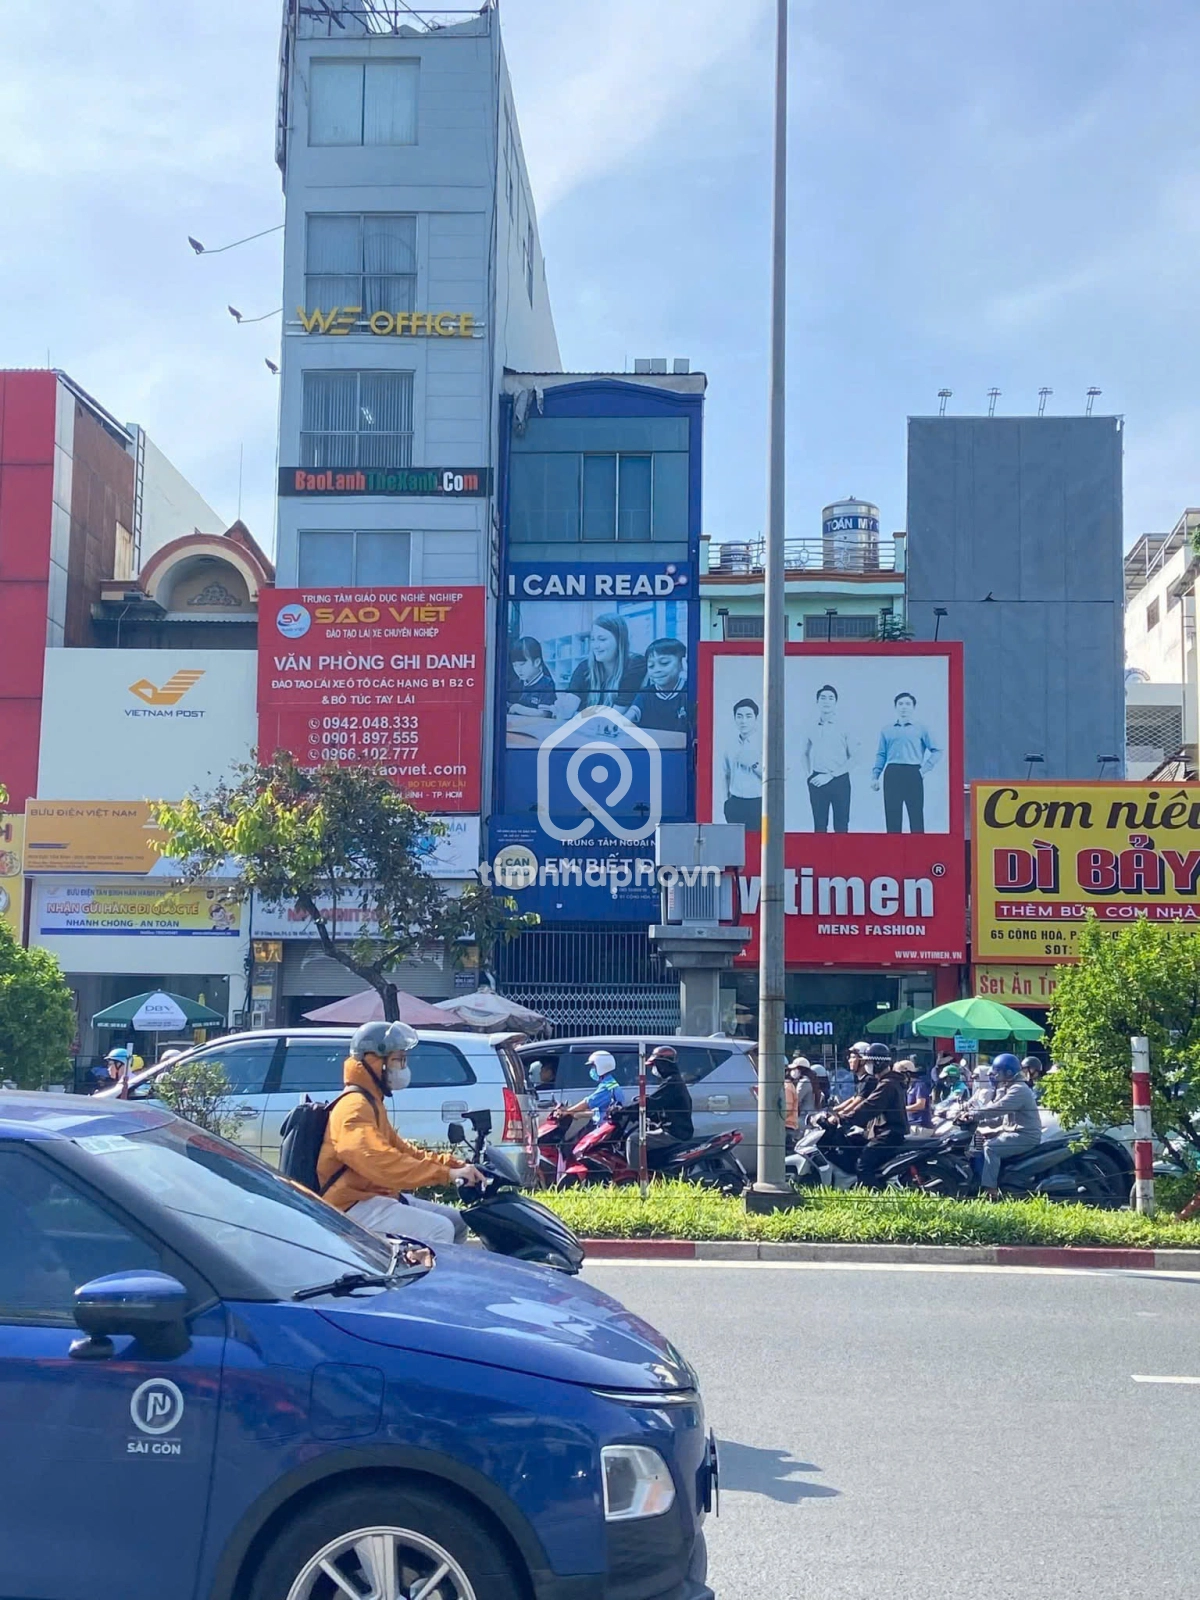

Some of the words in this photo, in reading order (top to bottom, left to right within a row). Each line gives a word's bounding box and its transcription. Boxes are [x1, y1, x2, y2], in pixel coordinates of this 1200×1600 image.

[370, 310, 474, 336] OFFICE
[508, 575, 516, 595] I
[522, 574, 586, 596] CAN
[595, 574, 675, 596] READ
[302, 594, 331, 603] TRUNG
[354, 591, 377, 603] GIÁO
[379, 593, 398, 604] DỤC
[314, 606, 381, 624] SAO
[388, 603, 452, 625] VIỆT
[343, 628, 357, 639] TẠO
[372, 628, 382, 638] XE
[273, 652, 311, 670] VĂN
[318, 650, 385, 670] PHÒNG
[390, 654, 420, 669] GHI
[426, 653, 476, 669] DANH
[271, 678, 293, 688] ĐÀO
[294, 679, 313, 690] TẠO
[314, 676, 331, 688] LÁI
[332, 679, 346, 688] XE
[372, 676, 395, 688] CÁC
[397, 679, 429, 689] HẠNG
[432, 679, 445, 688] B1
[449, 679, 463, 687] B2
[466, 677, 475, 687] C
[350, 693, 371, 705] TÚC
[375, 695, 393, 704] TAY
[397, 693, 415, 704] LÁI
[124, 709, 173, 717] VIETNAM
[176, 709, 206, 718] POST
[322, 716, 418, 729] 0942.048.333
[322, 731, 418, 745] 0901.897.555
[321, 747, 418, 760] 0966.102.777
[446, 791, 463, 799] HCM
[30, 807, 54, 816] BƯU
[86, 807, 109, 817] VIỆT
[111, 809, 137, 817] NAM
[983, 788, 1093, 829] Cơm
[561, 839, 595, 847] TRUNG
[597, 838, 617, 847] TÂM
[619, 839, 650, 849] NGOẠI
[505, 857, 530, 867] CAN
[544, 857, 576, 873] EM
[585, 852, 633, 874] BIẾT
[993, 838, 1057, 891] DÌ
[1076, 834, 1200, 892] BẢY
[739, 867, 934, 917] vtimen
[46, 902, 80, 916] NHẬN
[102, 901, 135, 915] HÀNG
[137, 902, 150, 914] ĐI
[1000, 903, 1052, 916] THÈM
[1106, 906, 1148, 917] CƠM
[1156, 905, 1197, 918] NHÀ
[101, 918, 133, 927] CHÓNG
[140, 919, 155, 927] AN
[156, 919, 180, 927] TOÀN
[817, 924, 860, 935] MENS
[865, 925, 926, 936] FASHION
[990, 929, 1004, 940] 65
[1008, 927, 1037, 942] CỘNG
[895, 950, 963, 960] WWW.VITIMEN.VN
[980, 974, 1005, 994] Set
[1012, 971, 1032, 995] Ăn
[1038, 976, 1056, 995] Tr
[784, 1018, 833, 1035] itimen
[127, 1440, 149, 1453] SÀI
[152, 1441, 181, 1454] GÒN
